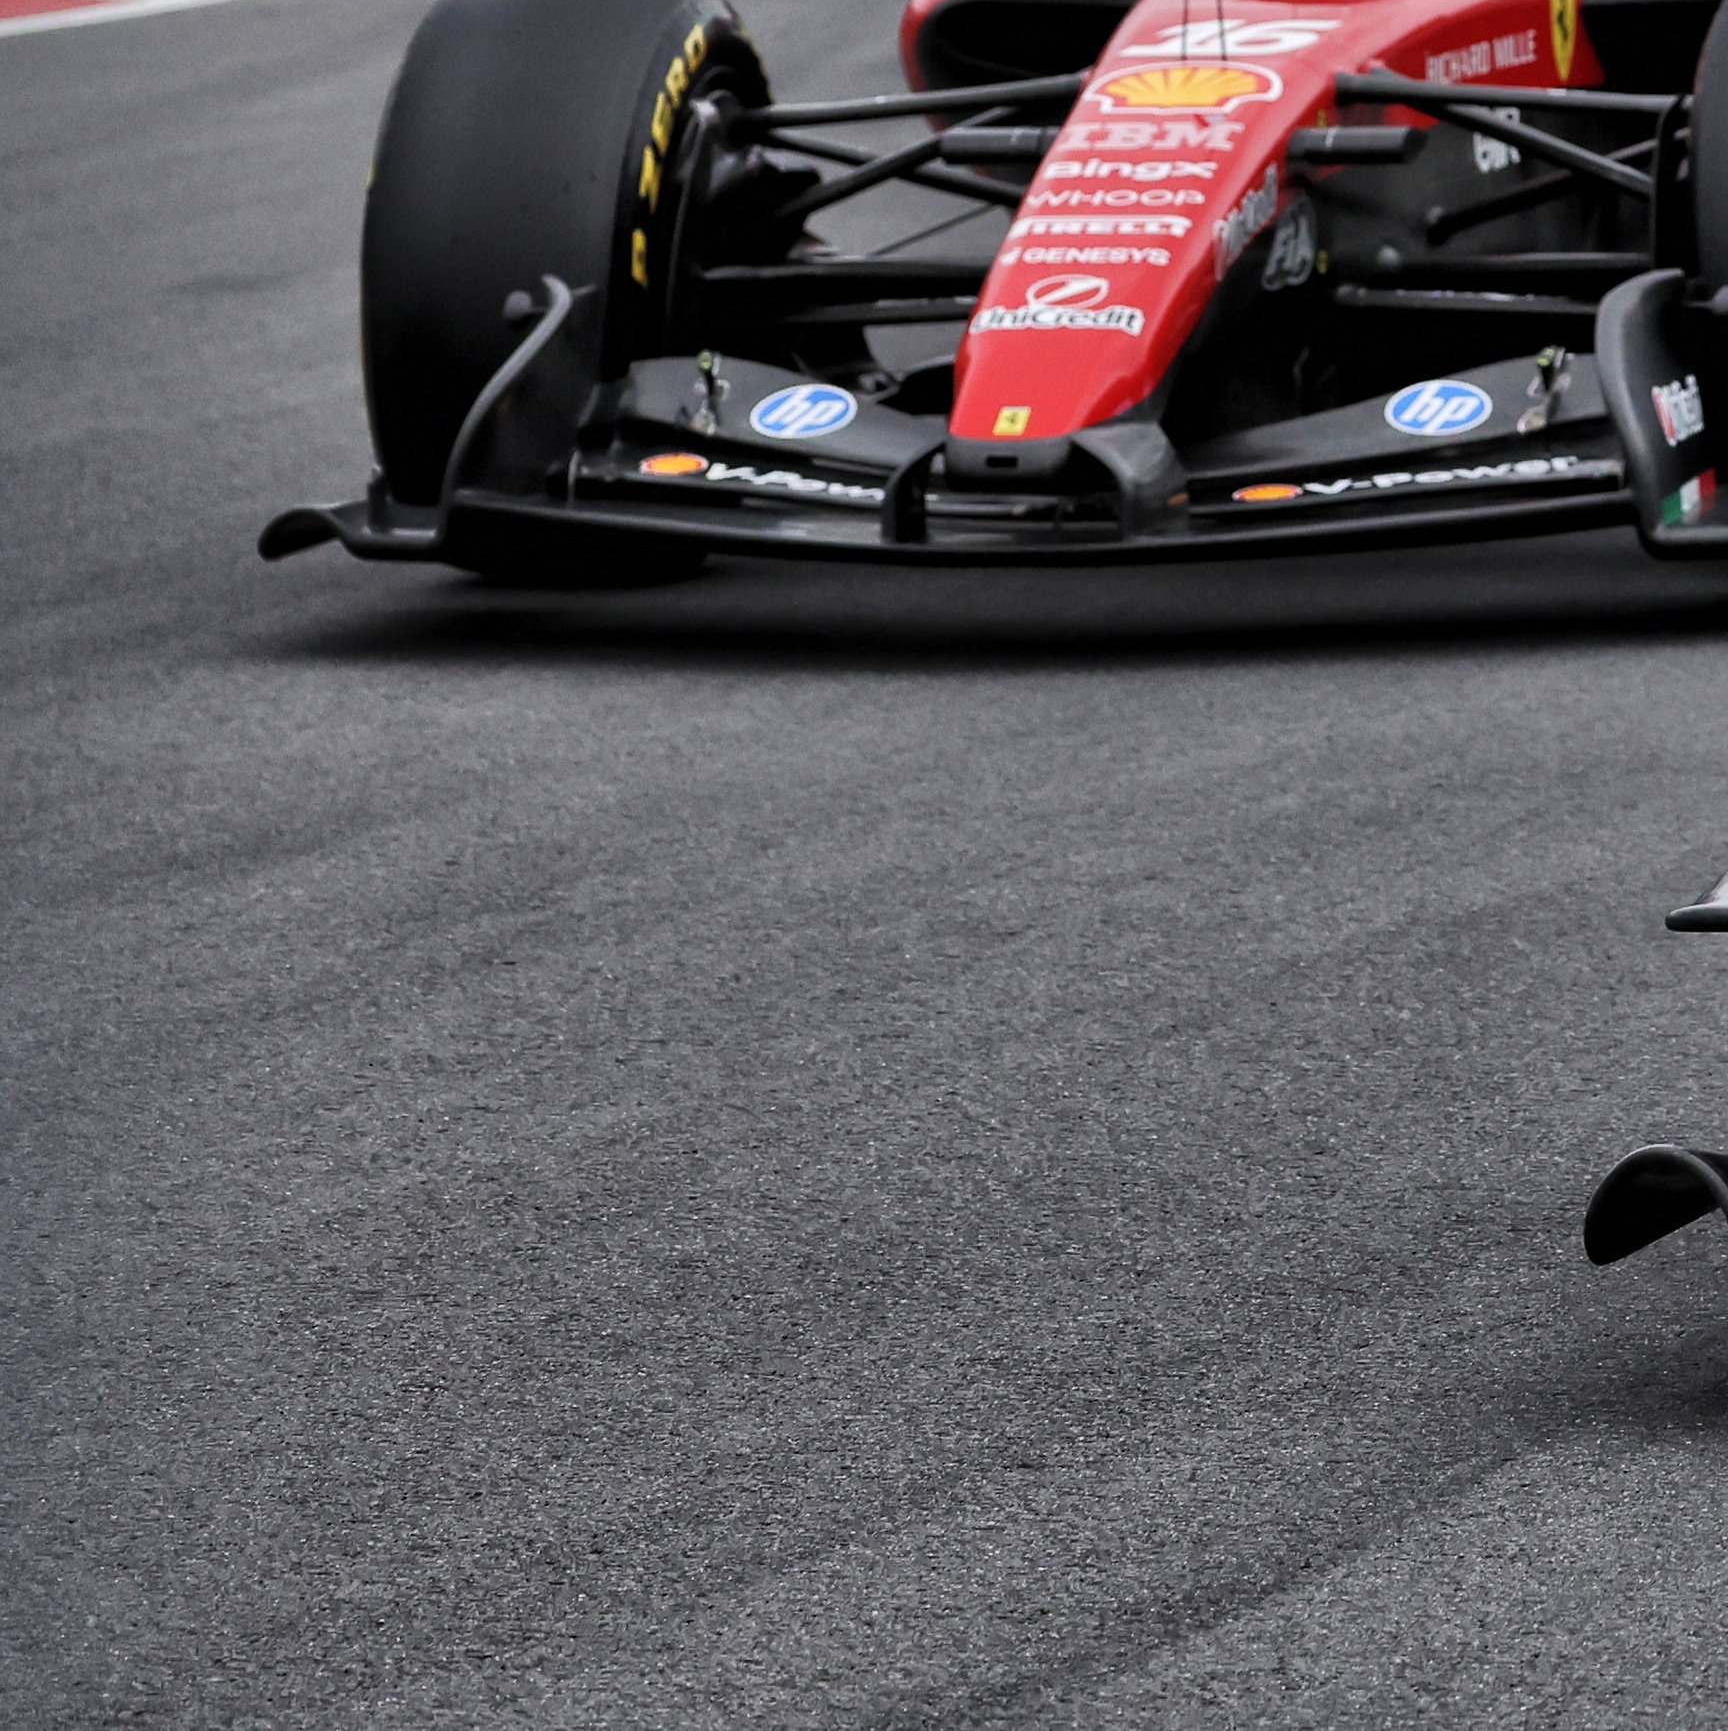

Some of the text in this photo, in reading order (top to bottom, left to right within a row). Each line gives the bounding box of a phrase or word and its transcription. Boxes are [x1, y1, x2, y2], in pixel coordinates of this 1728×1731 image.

[1120, 19, 1342, 57] 16
[1425, 30, 1537, 83] RICHARD MILLE
[1055, 121, 1245, 151] IBM
[1027, 190, 1206, 207] WHOOP
[1007, 215, 1193, 239] PIRELLI
[1021, 247, 1171, 267] GENESYS
[761, 386, 849, 436] hp
[1400, 381, 1481, 434] hp
